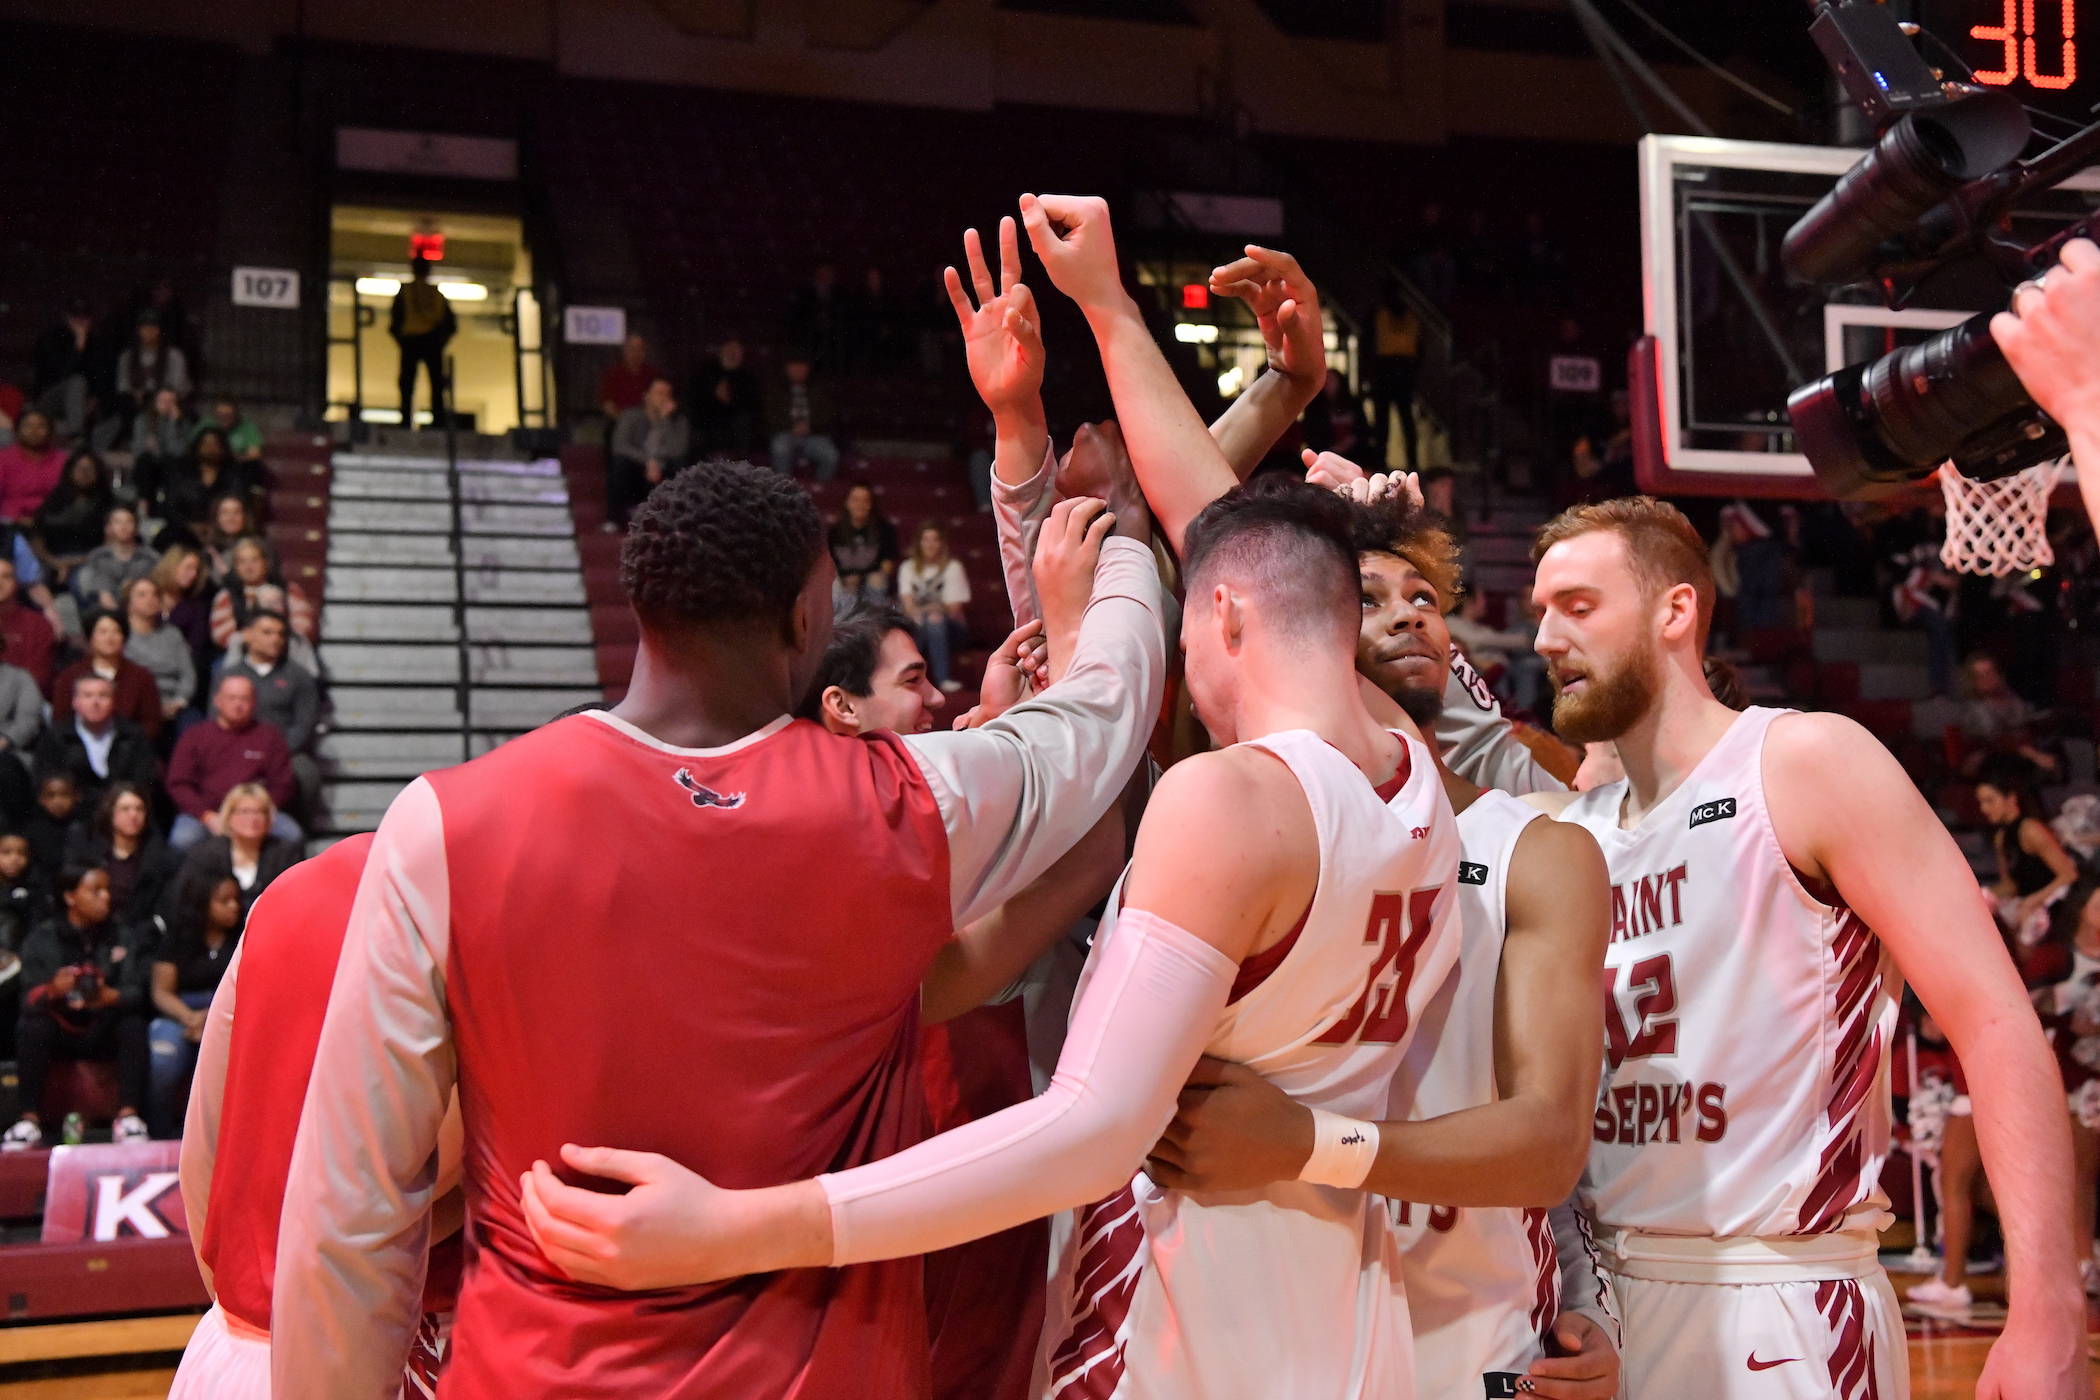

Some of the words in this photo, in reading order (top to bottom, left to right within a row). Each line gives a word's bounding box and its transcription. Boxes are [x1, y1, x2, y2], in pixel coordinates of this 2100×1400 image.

[1970, 0, 2077, 90] 30
[244, 274, 289, 299] 107
[1609, 860, 1688, 943] AINT
[1602, 950, 1680, 1074] 12
[1593, 1079, 1728, 1148] SEPH'S
[93, 1170, 179, 1242] K
